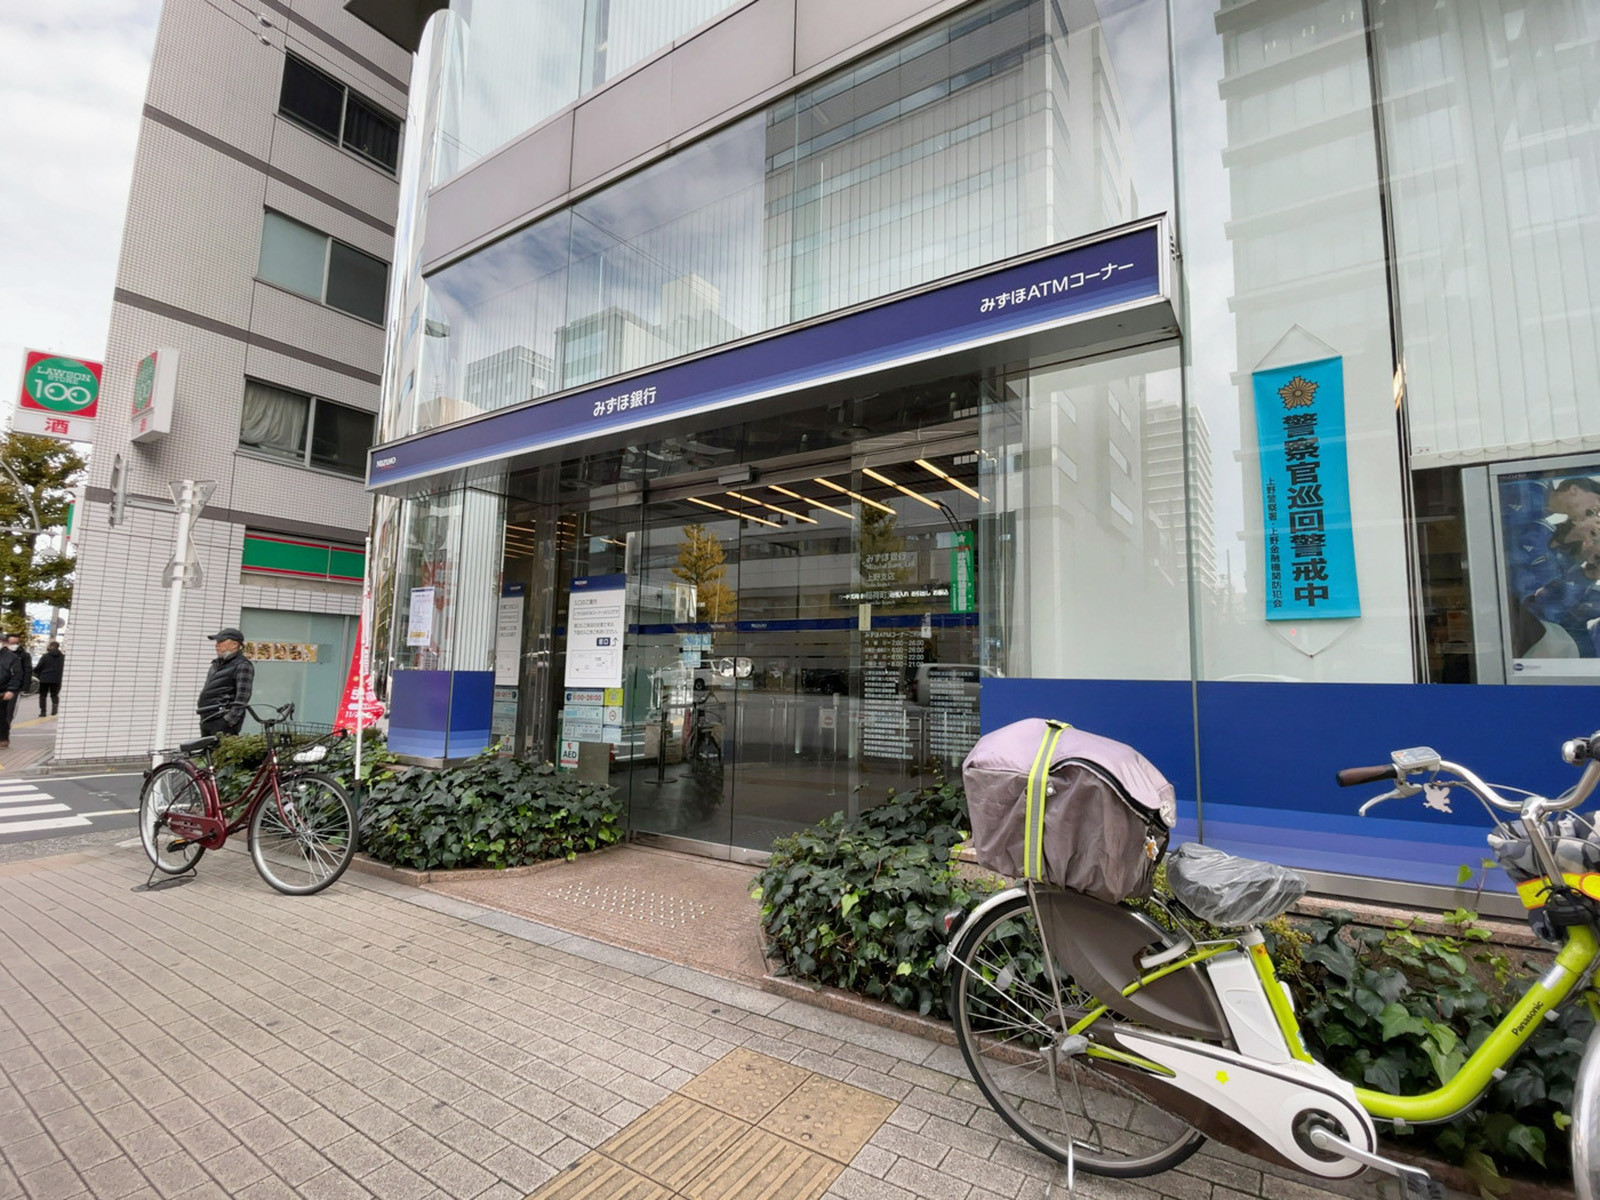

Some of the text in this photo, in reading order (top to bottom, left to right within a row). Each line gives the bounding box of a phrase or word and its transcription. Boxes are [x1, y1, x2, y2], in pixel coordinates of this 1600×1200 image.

[979, 263, 1134, 313] みずほATMコーナー
[36, 366, 91, 382] LAWSON
[34, 379, 91, 405] 100
[592, 386, 657, 417] みずほ銀行
[44, 417, 70, 435] 酒
[1282, 412, 1330, 607] 警察官巡回警戒中
[562, 750, 577, 759] AED
[1511, 1000, 1544, 1037] Panasonic
